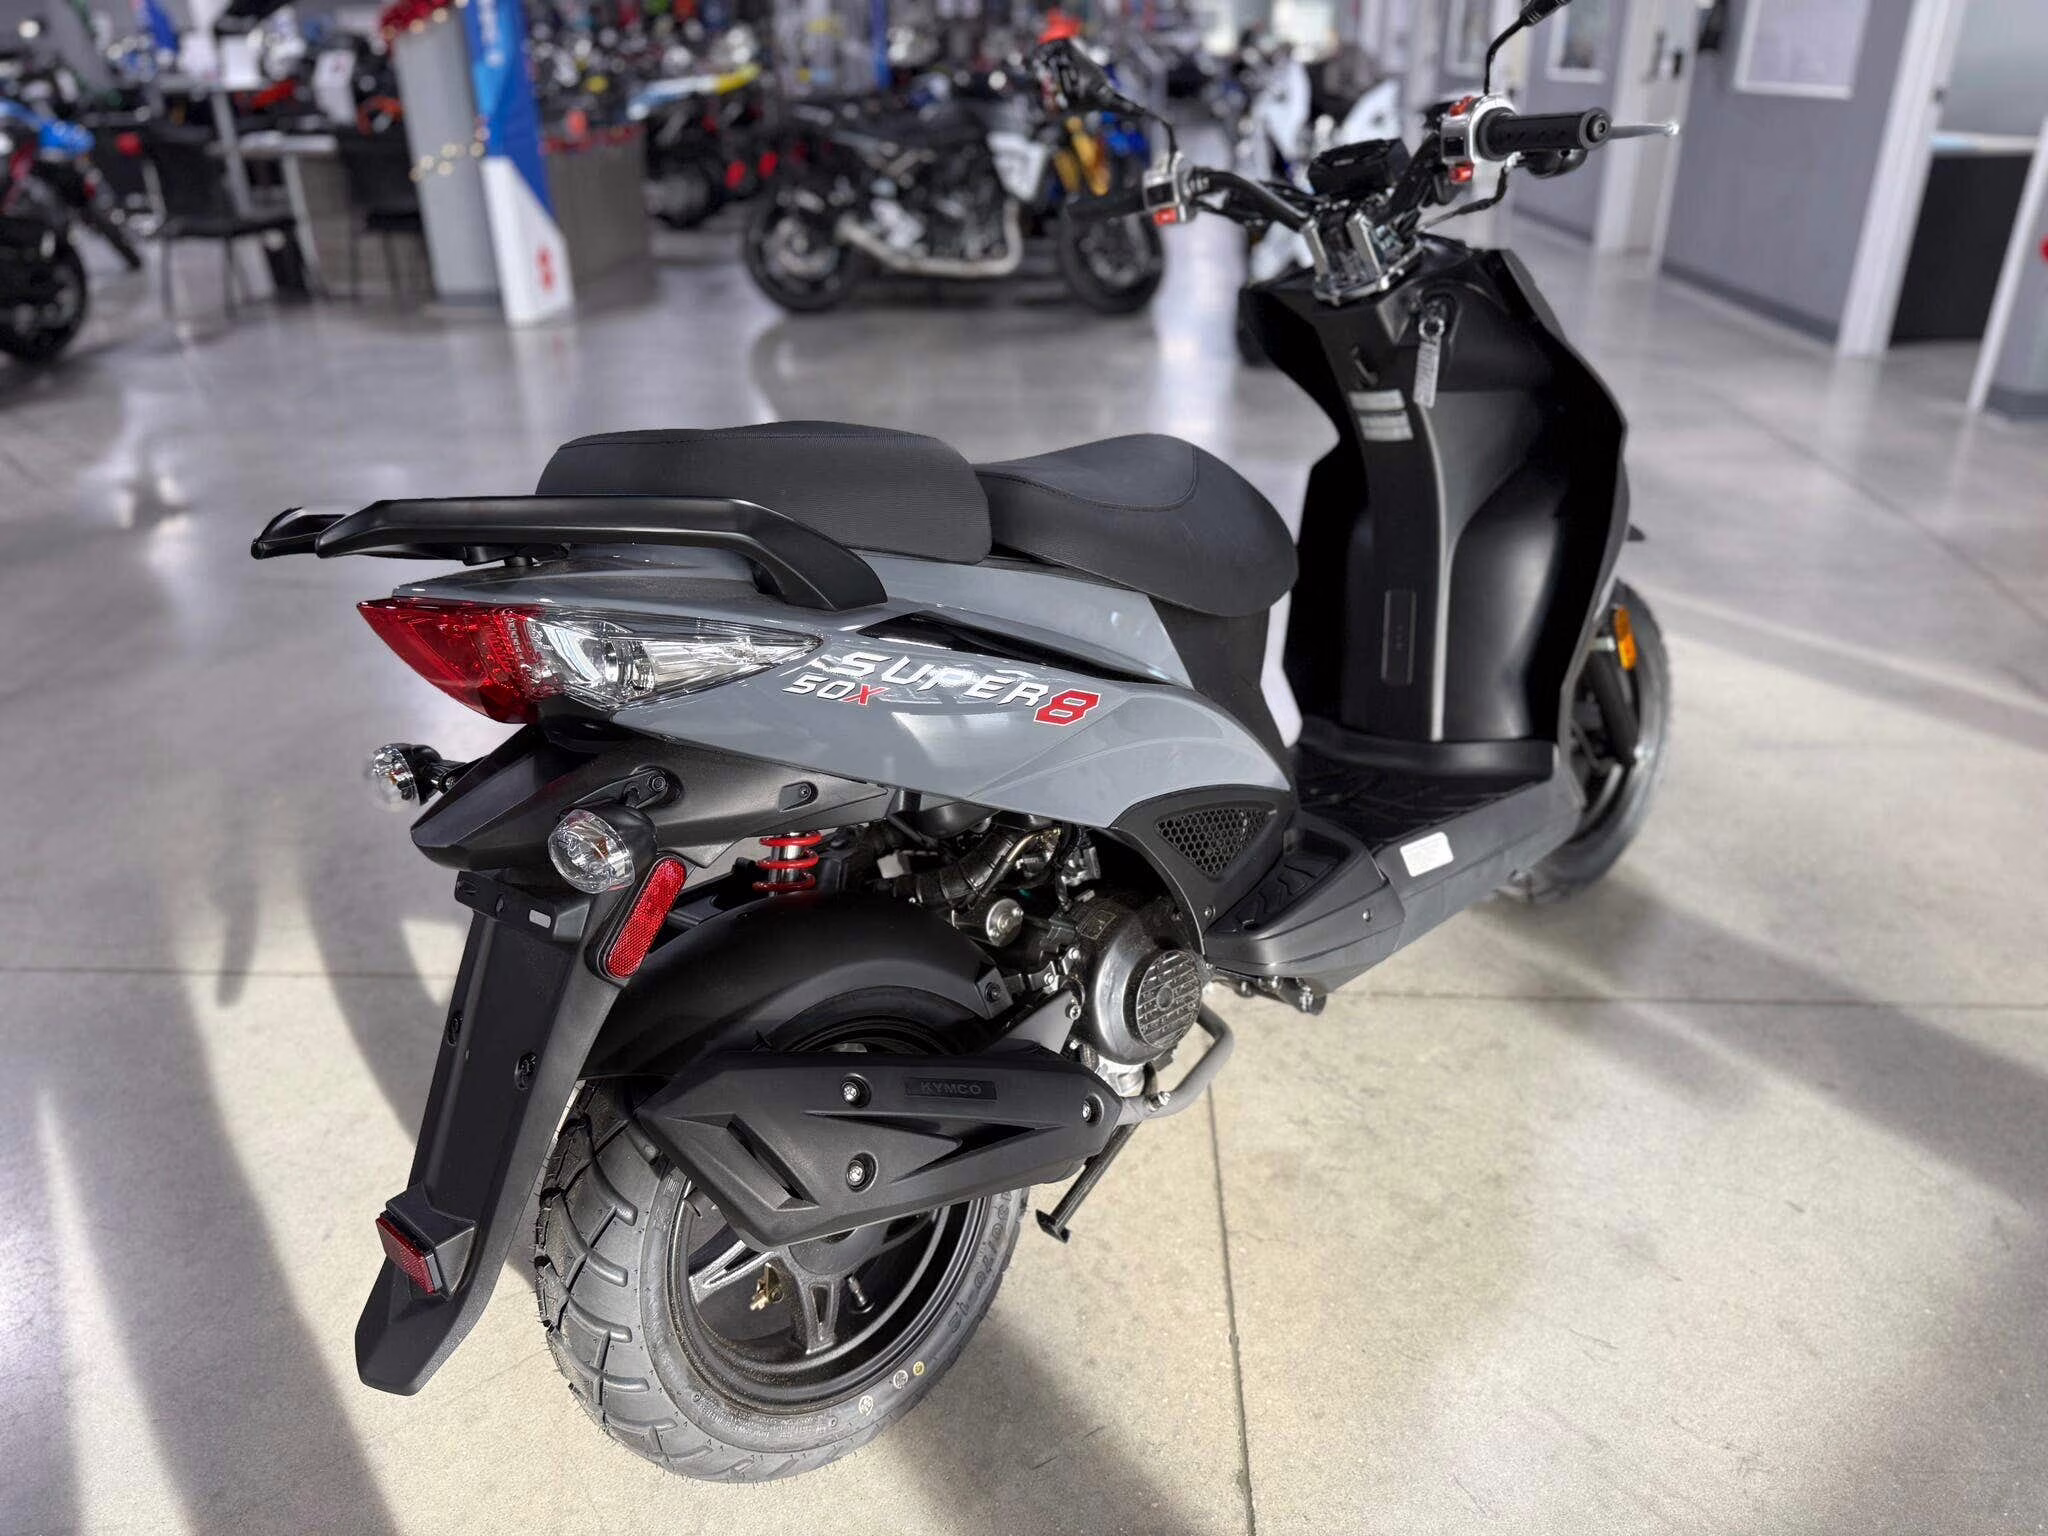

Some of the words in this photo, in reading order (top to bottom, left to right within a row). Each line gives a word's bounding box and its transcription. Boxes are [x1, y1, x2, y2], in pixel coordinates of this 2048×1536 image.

[782, 674, 889, 706] 50X
[832, 651, 1050, 709] SUPER
[1033, 688, 1101, 727] 8
[920, 1081, 982, 1096] KYMCO
